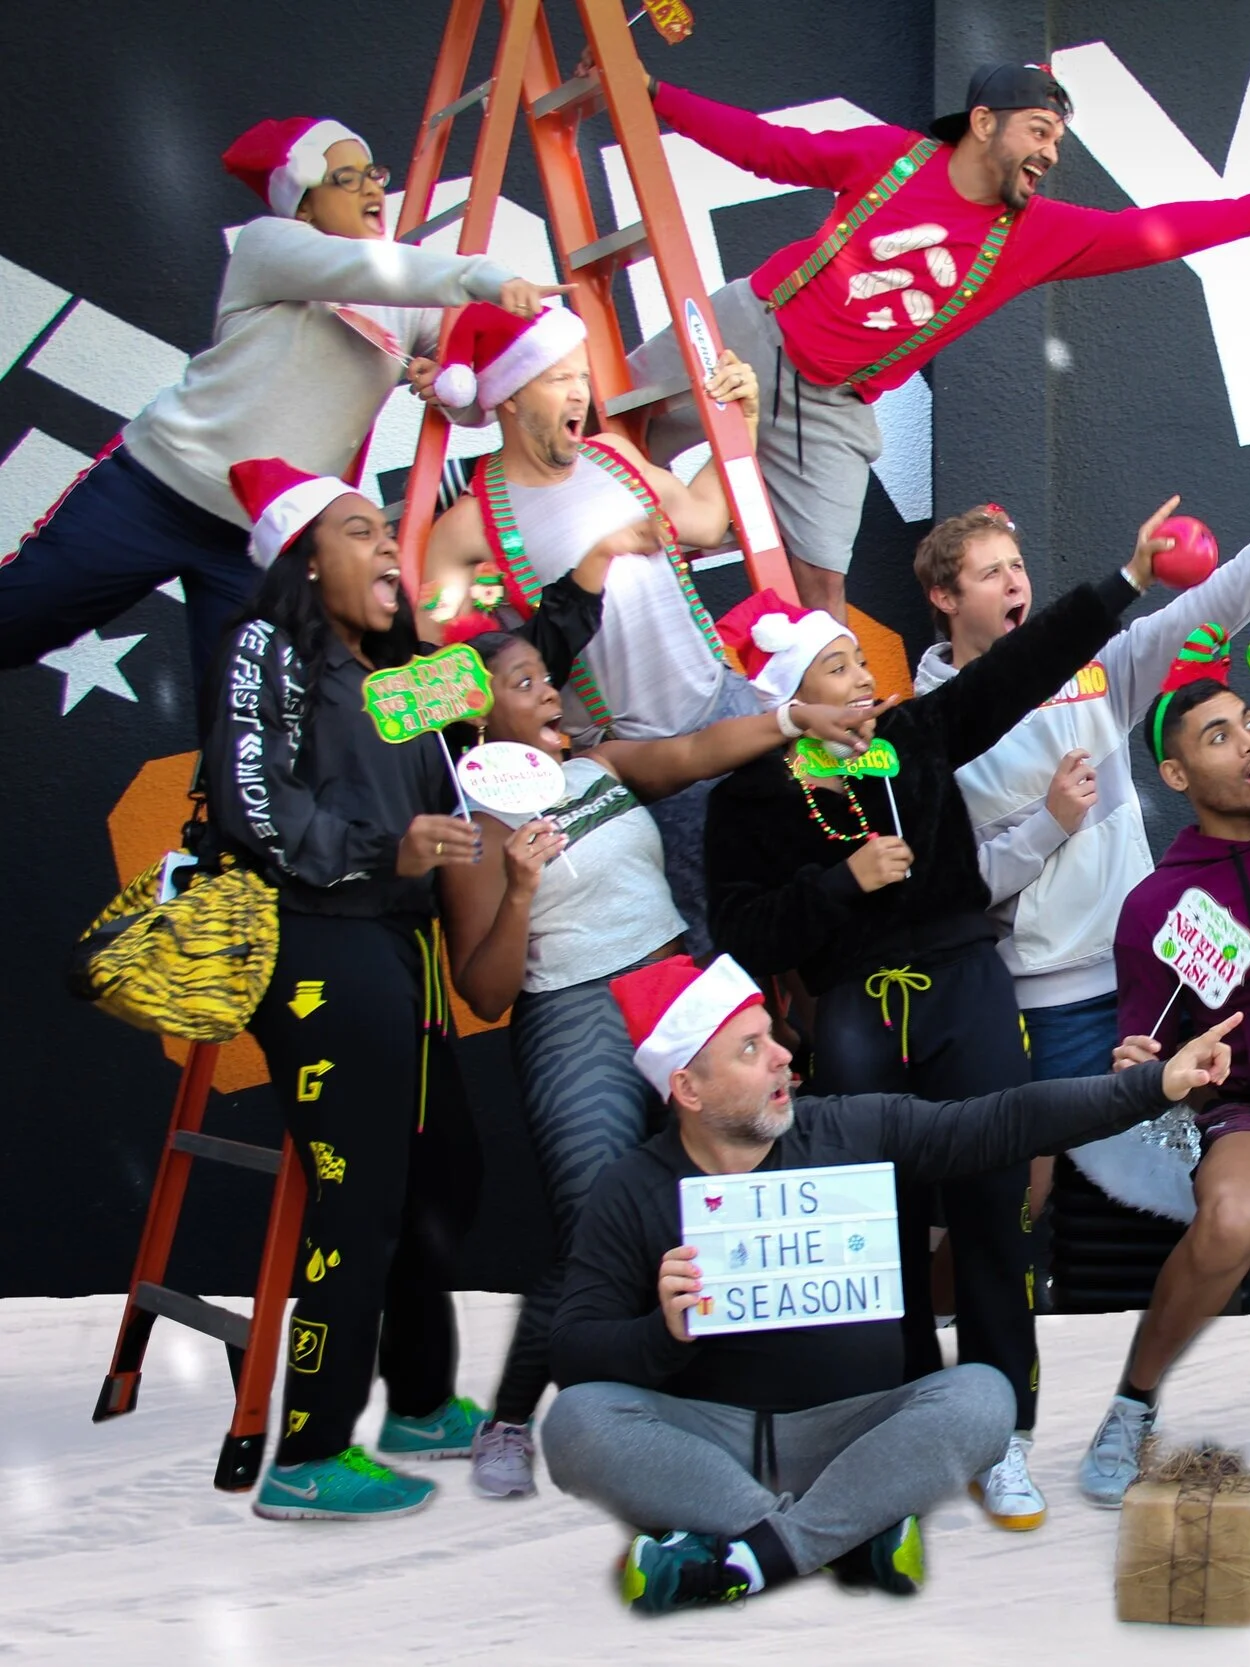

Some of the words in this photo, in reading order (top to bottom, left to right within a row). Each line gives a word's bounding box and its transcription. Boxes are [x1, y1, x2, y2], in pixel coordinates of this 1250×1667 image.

[750, 1181, 819, 1218] TIS
[754, 1230, 825, 1268] THE
[726, 1275, 881, 1321] SEASON!
